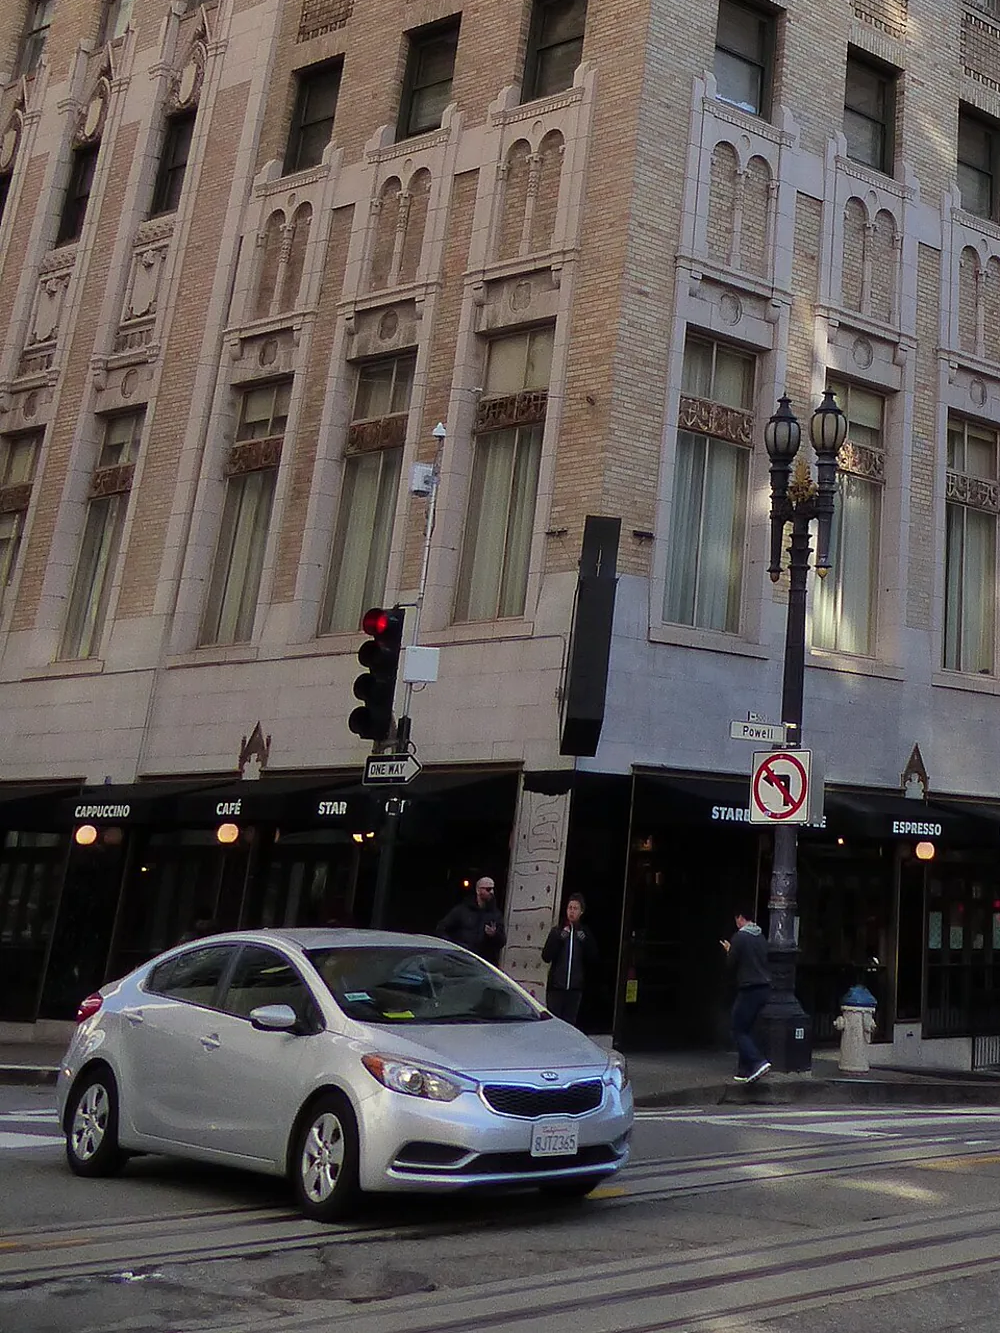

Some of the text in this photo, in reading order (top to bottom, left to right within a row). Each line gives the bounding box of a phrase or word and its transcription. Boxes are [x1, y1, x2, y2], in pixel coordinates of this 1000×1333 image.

[742, 725, 774, 740] Powell
[370, 763, 405, 775] ONE WAY
[75, 805, 131, 818] CAPPUCCINO
[216, 799, 242, 816] CAFÉ
[892, 821, 942, 836] ESPRESSO
